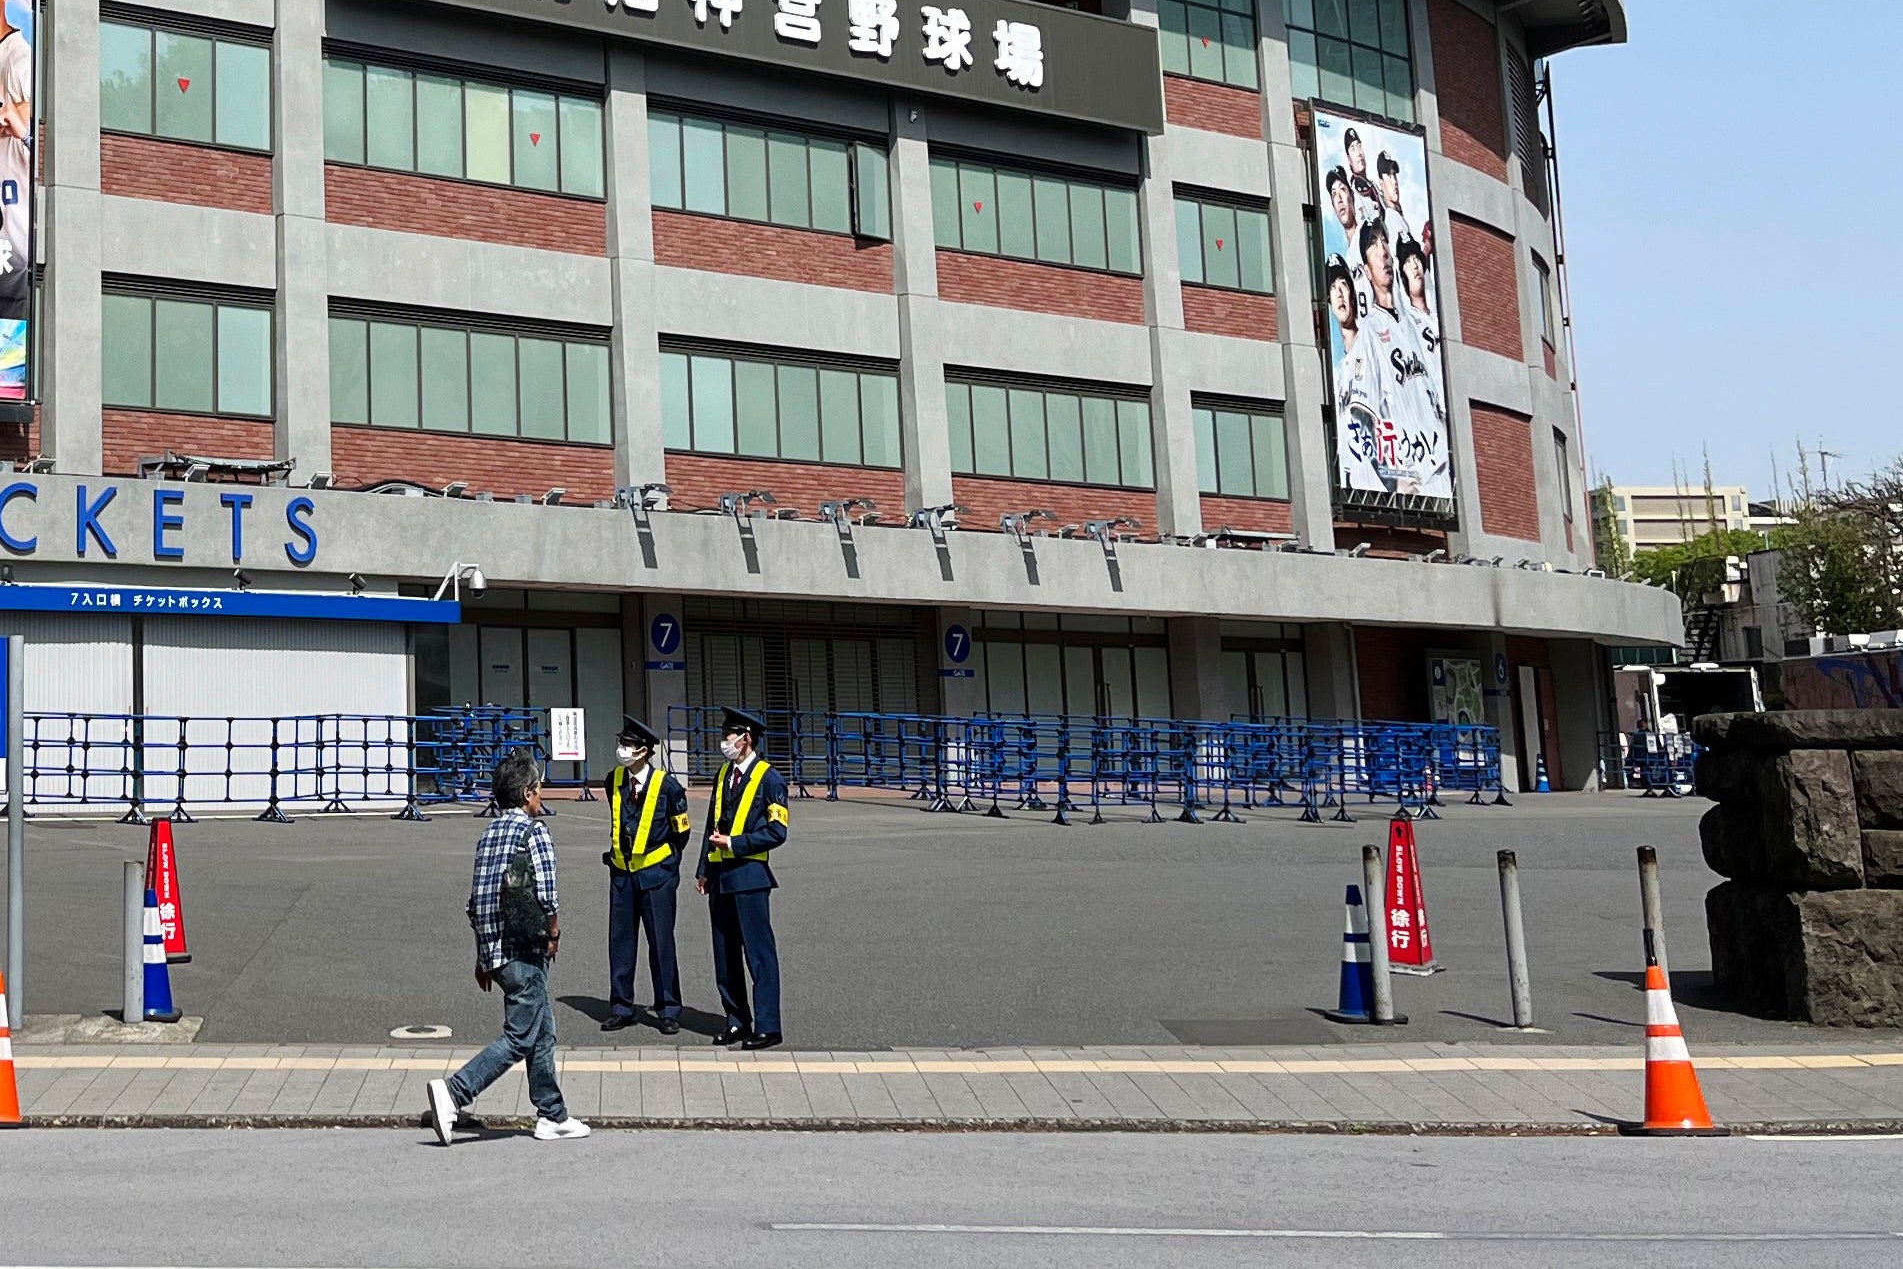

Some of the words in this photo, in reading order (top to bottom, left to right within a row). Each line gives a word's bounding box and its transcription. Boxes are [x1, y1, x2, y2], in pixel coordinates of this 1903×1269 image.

[71, 592, 121, 607] 7入口横
[133, 594, 223, 609] チケットボックス
[660, 623, 672, 648] 7
[952, 633, 963, 657] 7
[1395, 845, 1404, 874] SLOW
[1396, 875, 1405, 905] DOWN
[1390, 908, 1411, 949] 徐行
